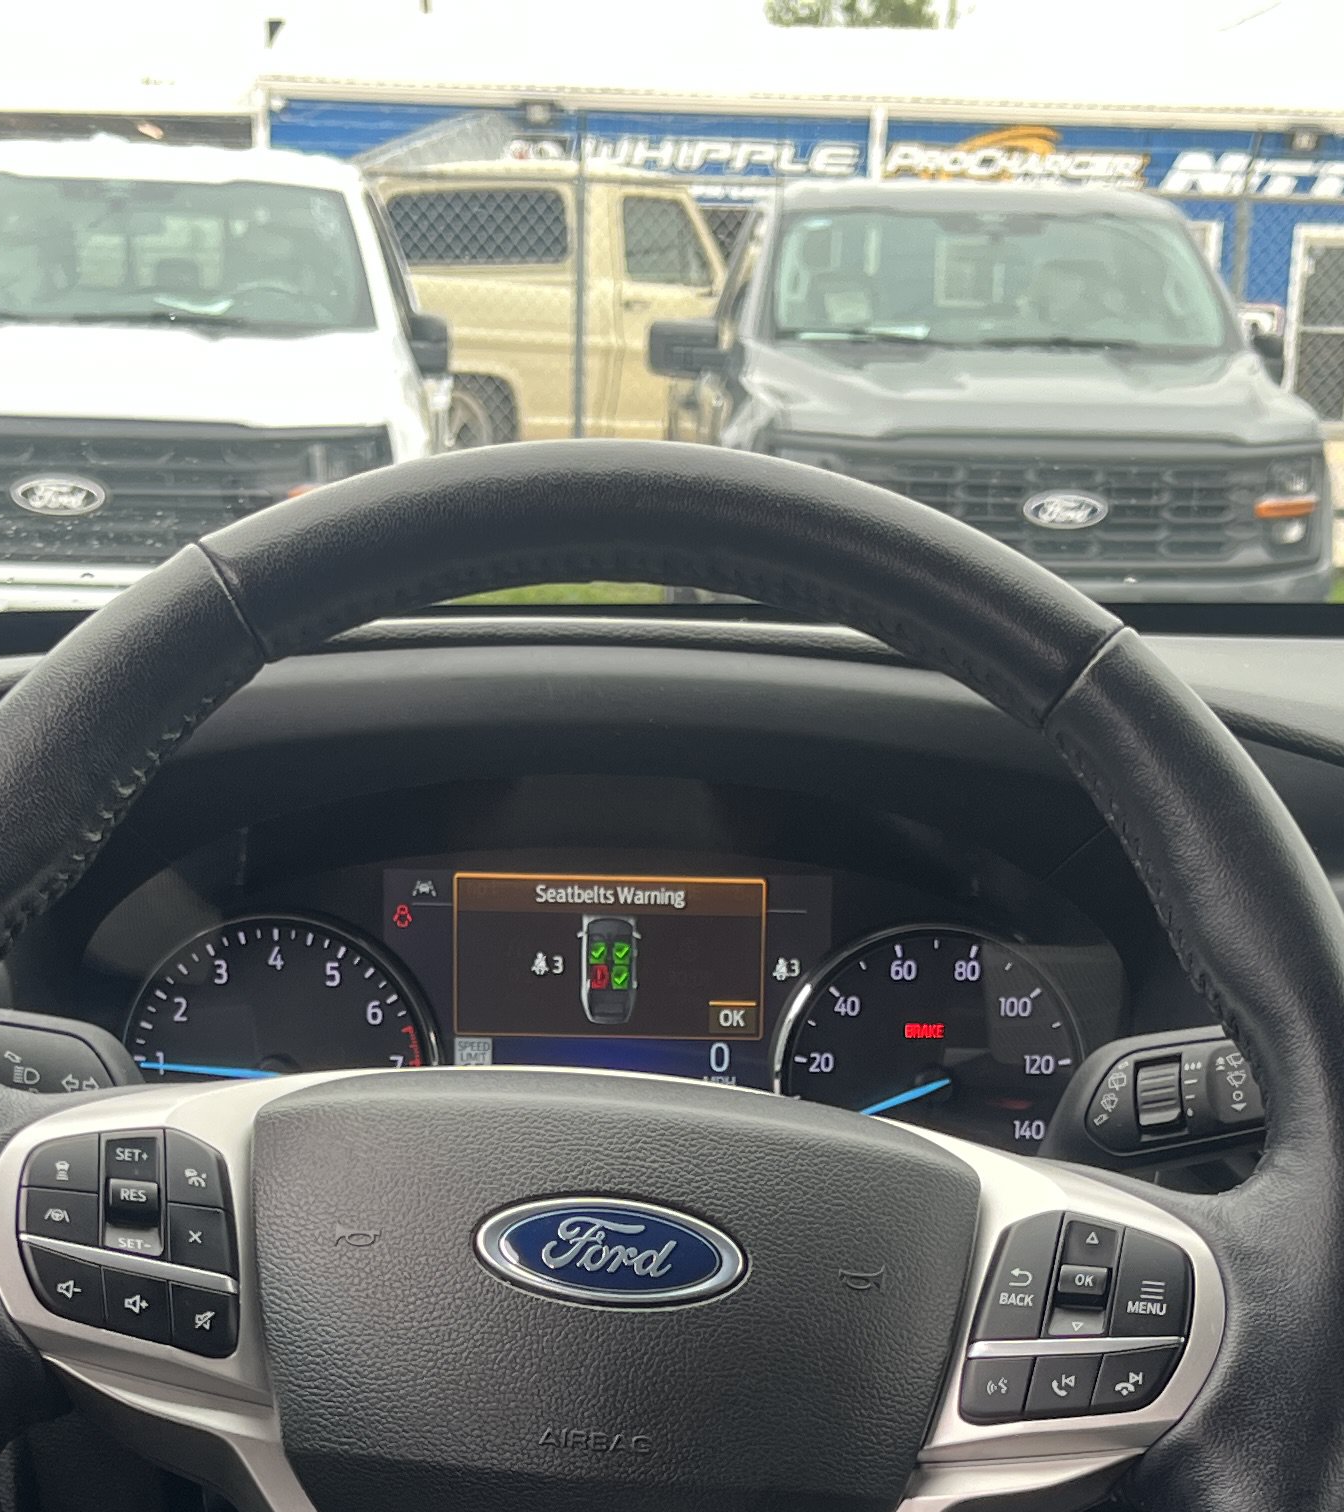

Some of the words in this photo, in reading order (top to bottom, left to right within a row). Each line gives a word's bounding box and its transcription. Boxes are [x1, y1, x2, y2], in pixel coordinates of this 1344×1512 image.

[580, 132, 860, 175] WHIPPLE
[534, 884, 615, 905] Seatbelts
[616, 886, 687, 910] Warning
[267, 946, 285, 970] 4
[551, 954, 566, 975] 3
[787, 958, 802, 978] 3
[213, 959, 229, 985] 3
[324, 961, 341, 987] 5
[889, 960, 918, 982] 60
[953, 960, 981, 982] 80
[173, 997, 188, 1022] 2
[365, 1000, 384, 1026] 6
[833, 996, 861, 1017] 40
[998, 996, 1032, 1017] 100
[718, 1009, 747, 1028] OK
[904, 1022, 945, 1039] BRAKE
[457, 1040, 491, 1052] SPEED
[709, 1041, 731, 1073] 0
[808, 1052, 835, 1073] 20
[1023, 1054, 1056, 1075] 120
[1013, 1119, 1046, 1141] 140
[119, 1187, 148, 1203] RES
[541, 1214, 680, 1280] Ford
[1074, 1273, 1095, 1288] OK
[998, 1292, 1034, 1308] BACK
[1126, 1300, 1168, 1317] MENU
[538, 1427, 655, 1456] AIRBAG
